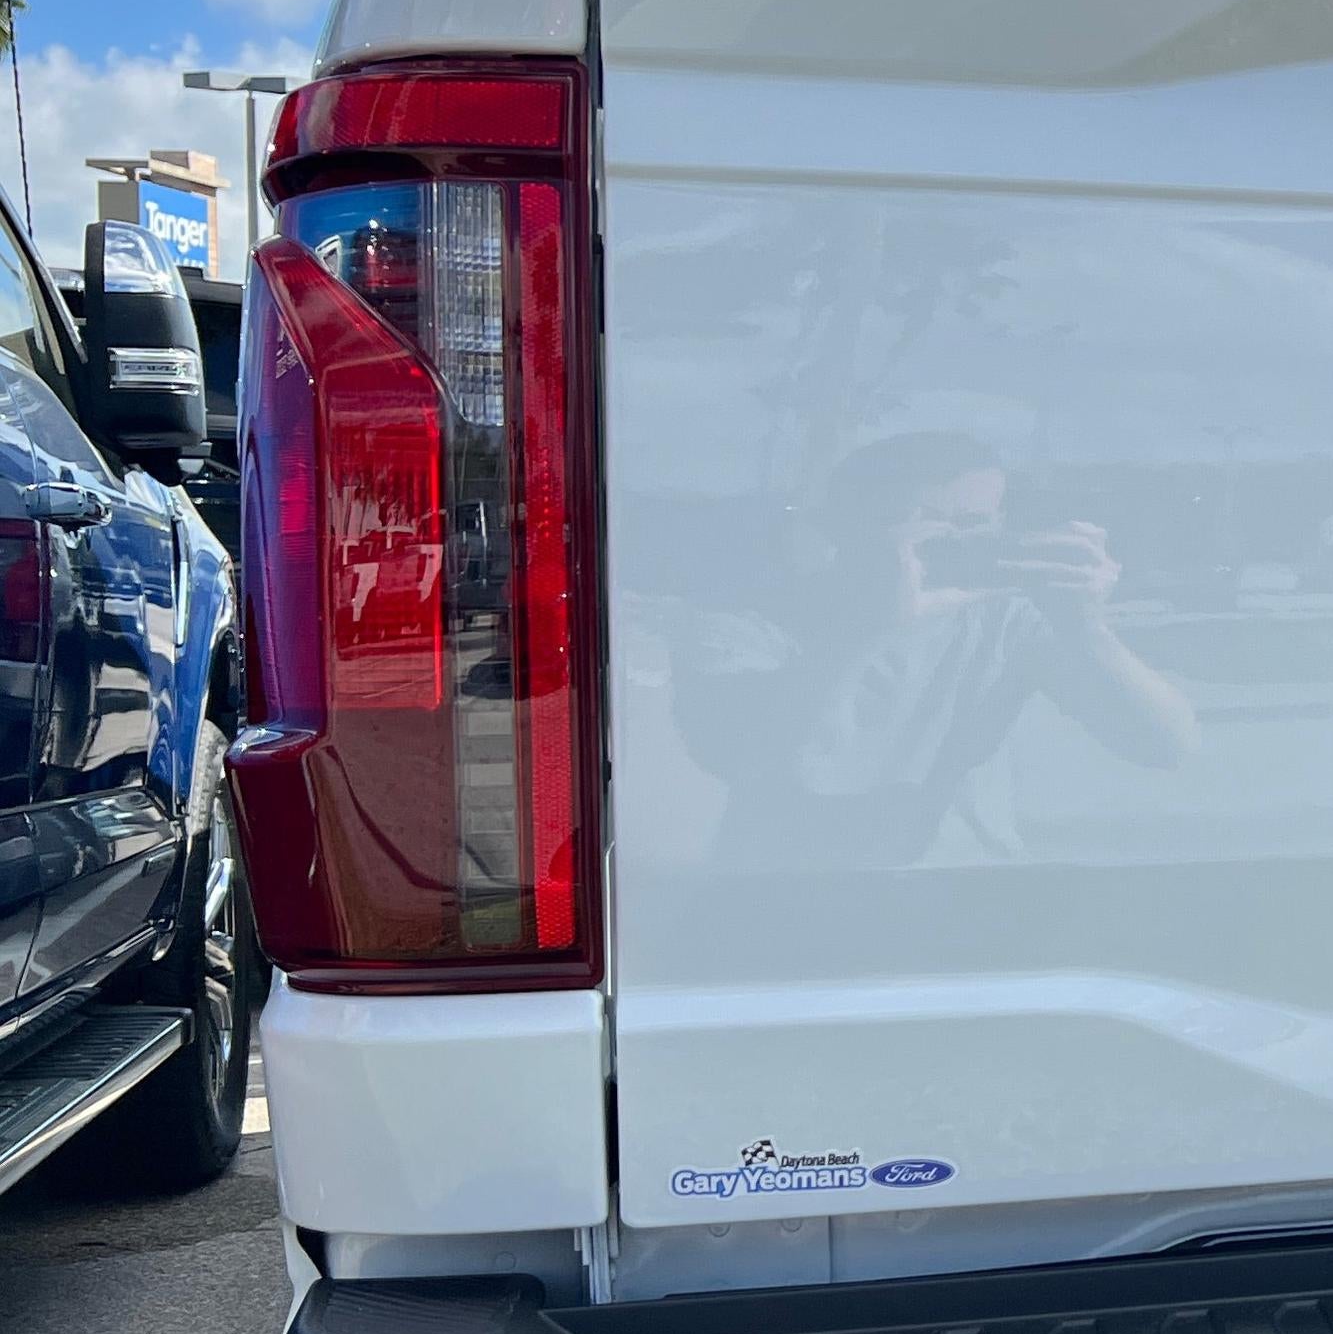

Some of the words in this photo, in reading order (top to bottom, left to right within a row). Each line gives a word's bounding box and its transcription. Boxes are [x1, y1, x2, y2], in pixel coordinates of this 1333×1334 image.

[145, 200, 208, 254] Tanger
[780, 1154, 826, 1169] Daytona
[827, 1152, 860, 1166] Beach
[673, 1170, 739, 1197] Gary
[740, 1167, 867, 1192] Yeomans
[884, 1164, 938, 1182] Ford
